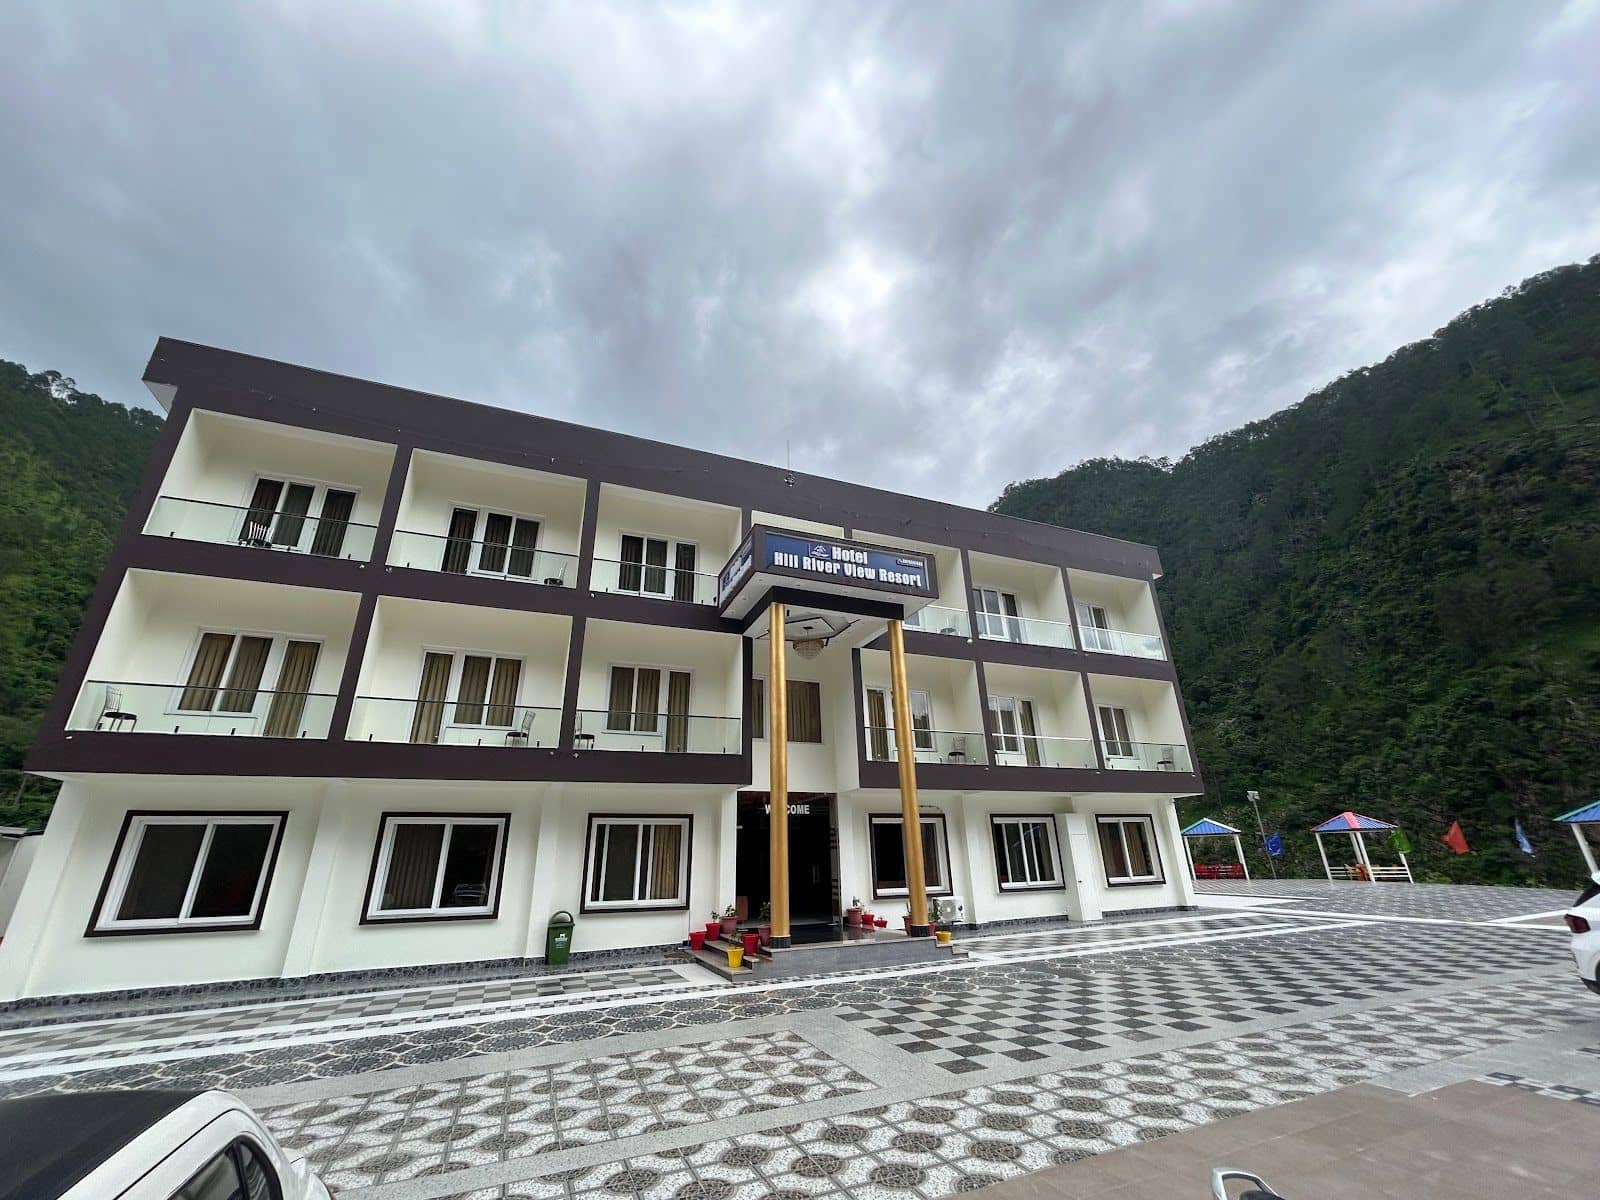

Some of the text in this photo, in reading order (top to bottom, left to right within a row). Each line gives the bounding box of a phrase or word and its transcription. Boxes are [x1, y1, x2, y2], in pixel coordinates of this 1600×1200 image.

[832, 546, 868, 564] Hotel
[774, 551, 921, 587] Hill River View Resort
[764, 803, 810, 815] WCOME
